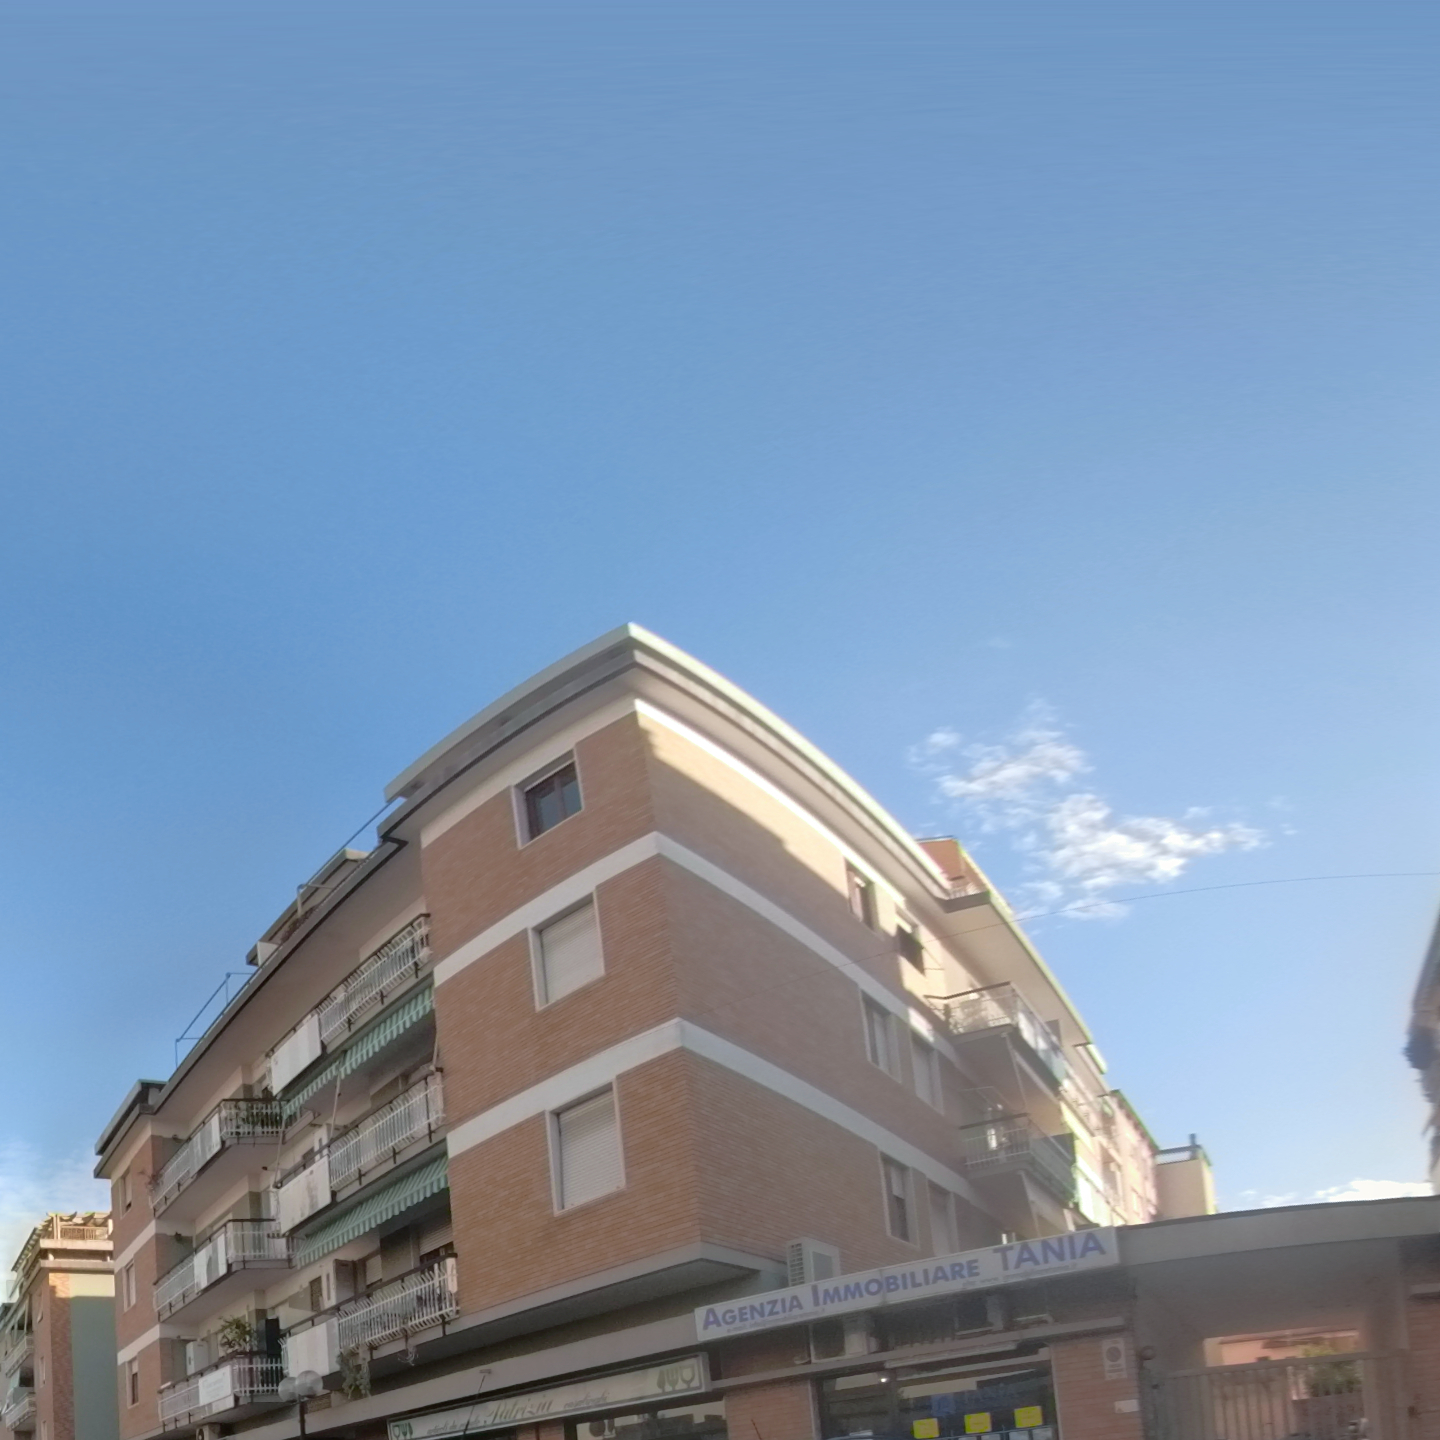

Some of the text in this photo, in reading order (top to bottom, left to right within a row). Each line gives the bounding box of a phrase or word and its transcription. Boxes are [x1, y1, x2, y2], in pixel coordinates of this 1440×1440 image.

[703, 1295, 803, 1330] AGENZIA
[811, 1259, 980, 1308] IMMOBILIARE
[993, 1233, 1107, 1271] TANIA
[486, 1395, 553, 1424] Patrizia
